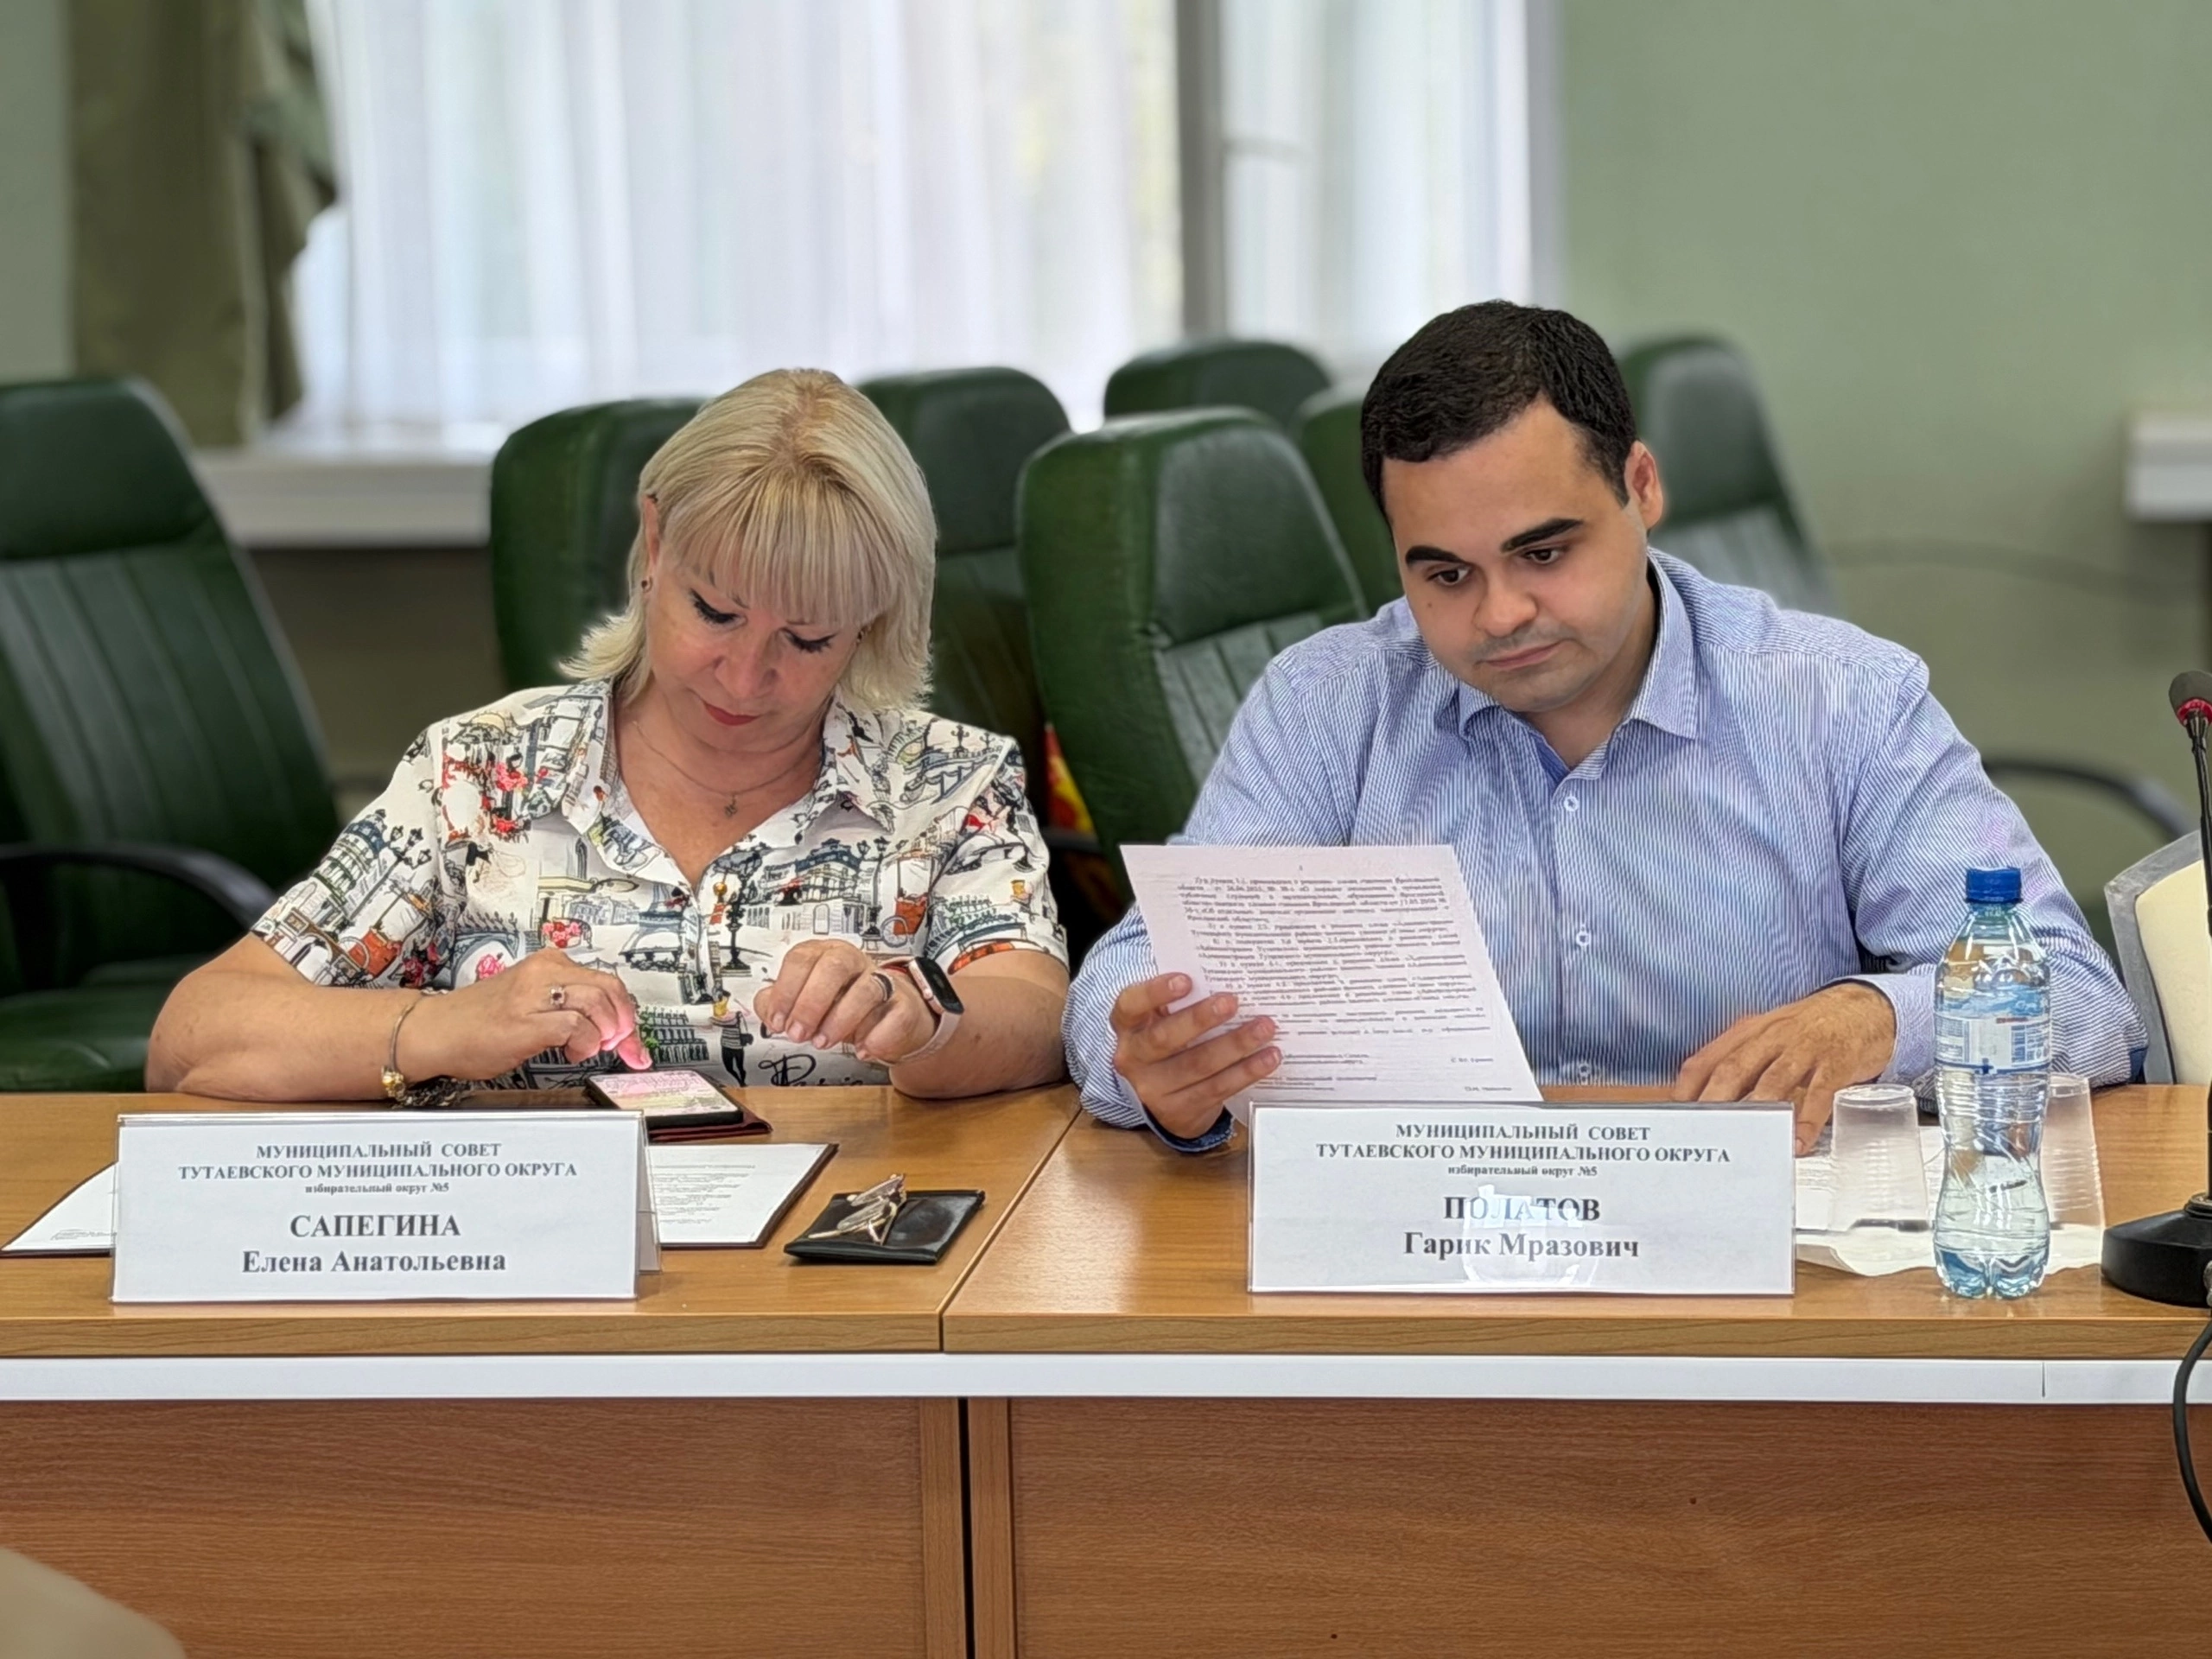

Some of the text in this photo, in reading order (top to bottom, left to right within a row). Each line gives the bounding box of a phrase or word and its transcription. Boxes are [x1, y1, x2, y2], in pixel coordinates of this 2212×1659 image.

[1395, 1123, 1650, 1141] МУНИЦИПАЛЬНЫЙ СОВЕТ
[257, 1141, 501, 1160] МУНИЦИПАЛЬНЫЙ СОВЕТ
[1316, 1143, 1731, 1162] ТУТАЕВСКОГО МУНИЦИПАЛЬНОГО ОКРУГА
[179, 1162, 577, 1179] ТУТАЕВСКОГО МУНИЦИПАЛЬНОГО ОКРУГА
[1448, 1164, 1598, 1178] избирательный округ №5
[305, 1182, 449, 1195] избирательный округ №5
[1444, 1196, 1600, 1221] ПОЛАТОВ
[289, 1214, 461, 1237] САПЕГИНА
[1404, 1231, 1639, 1262] Гарик Мразович
[242, 1250, 506, 1274] Елена Анатольевна
